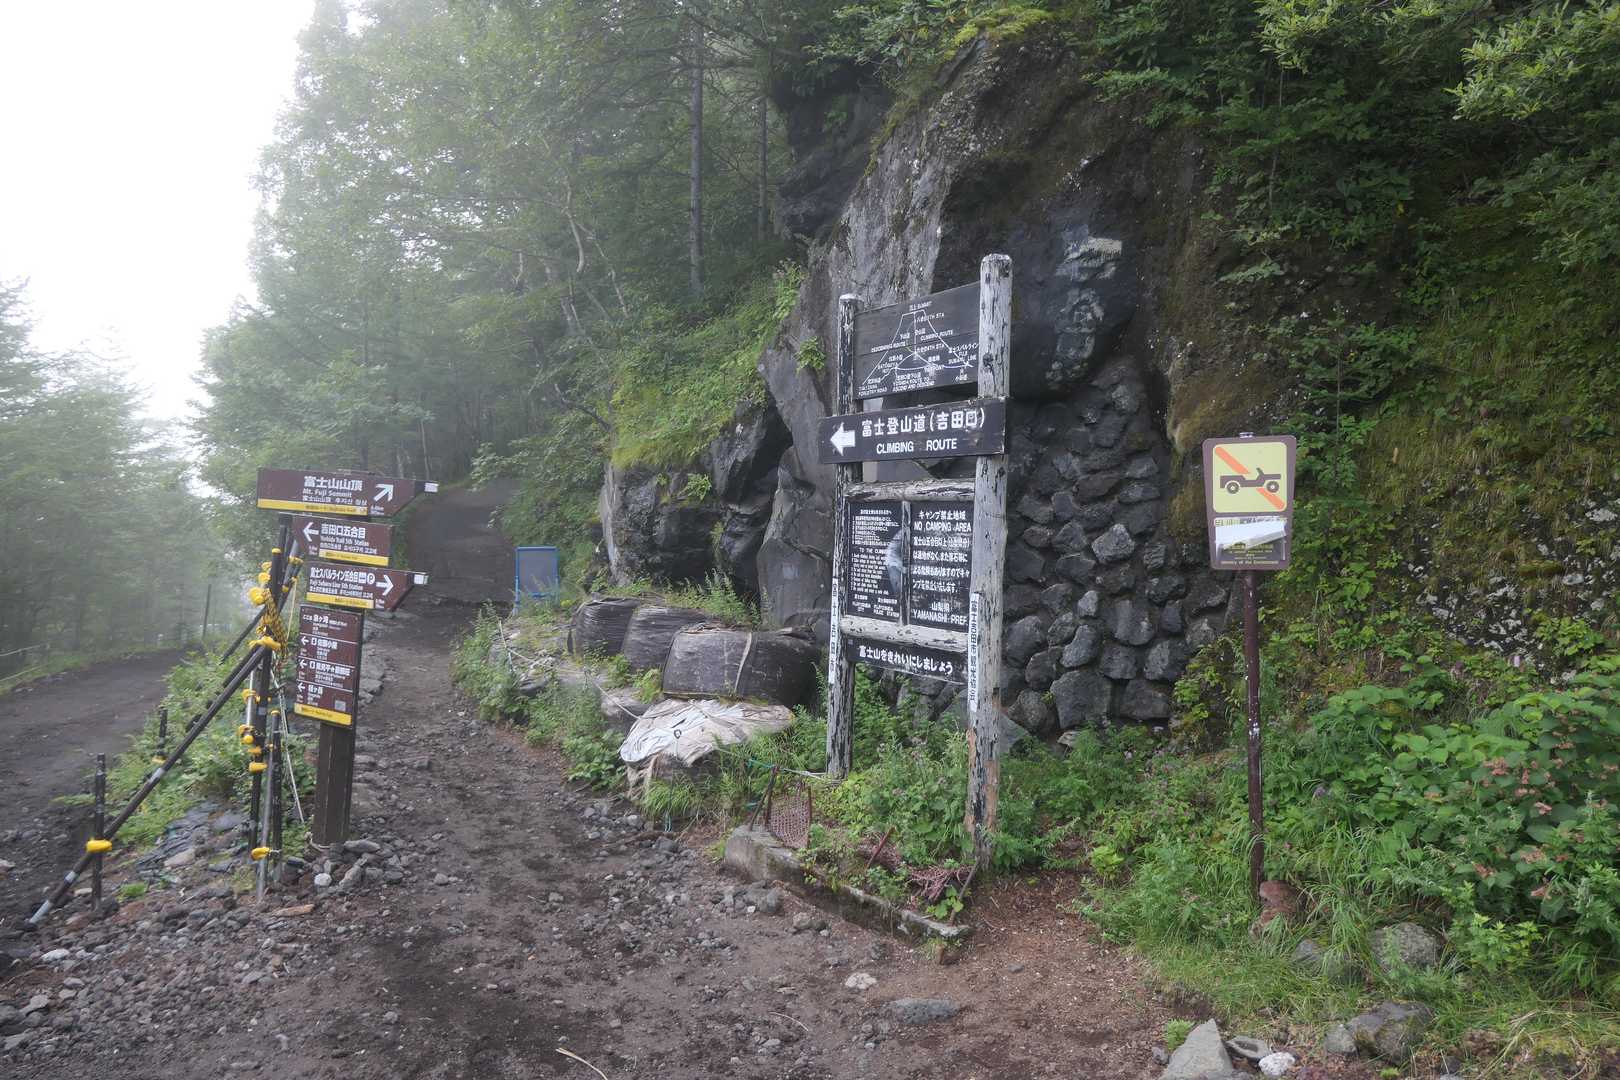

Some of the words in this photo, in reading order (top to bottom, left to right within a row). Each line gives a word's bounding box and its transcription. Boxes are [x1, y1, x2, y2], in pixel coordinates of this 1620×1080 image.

[876, 440, 914, 455] CLIMBING
[926, 438, 958, 451] ROUTE
[303, 475, 363, 492] 富士山山頂
[919, 509, 966, 521] キャンプ禁止地域
[321, 523, 366, 539] 吉田口五合目
[913, 520, 923, 532] NO
[925, 520, 952, 532] CAMPING
[954, 521, 972, 533] AREA
[912, 608, 948, 623] YAMANASHI
[858, 644, 953, 675] 富士山をきれいにしましょう
